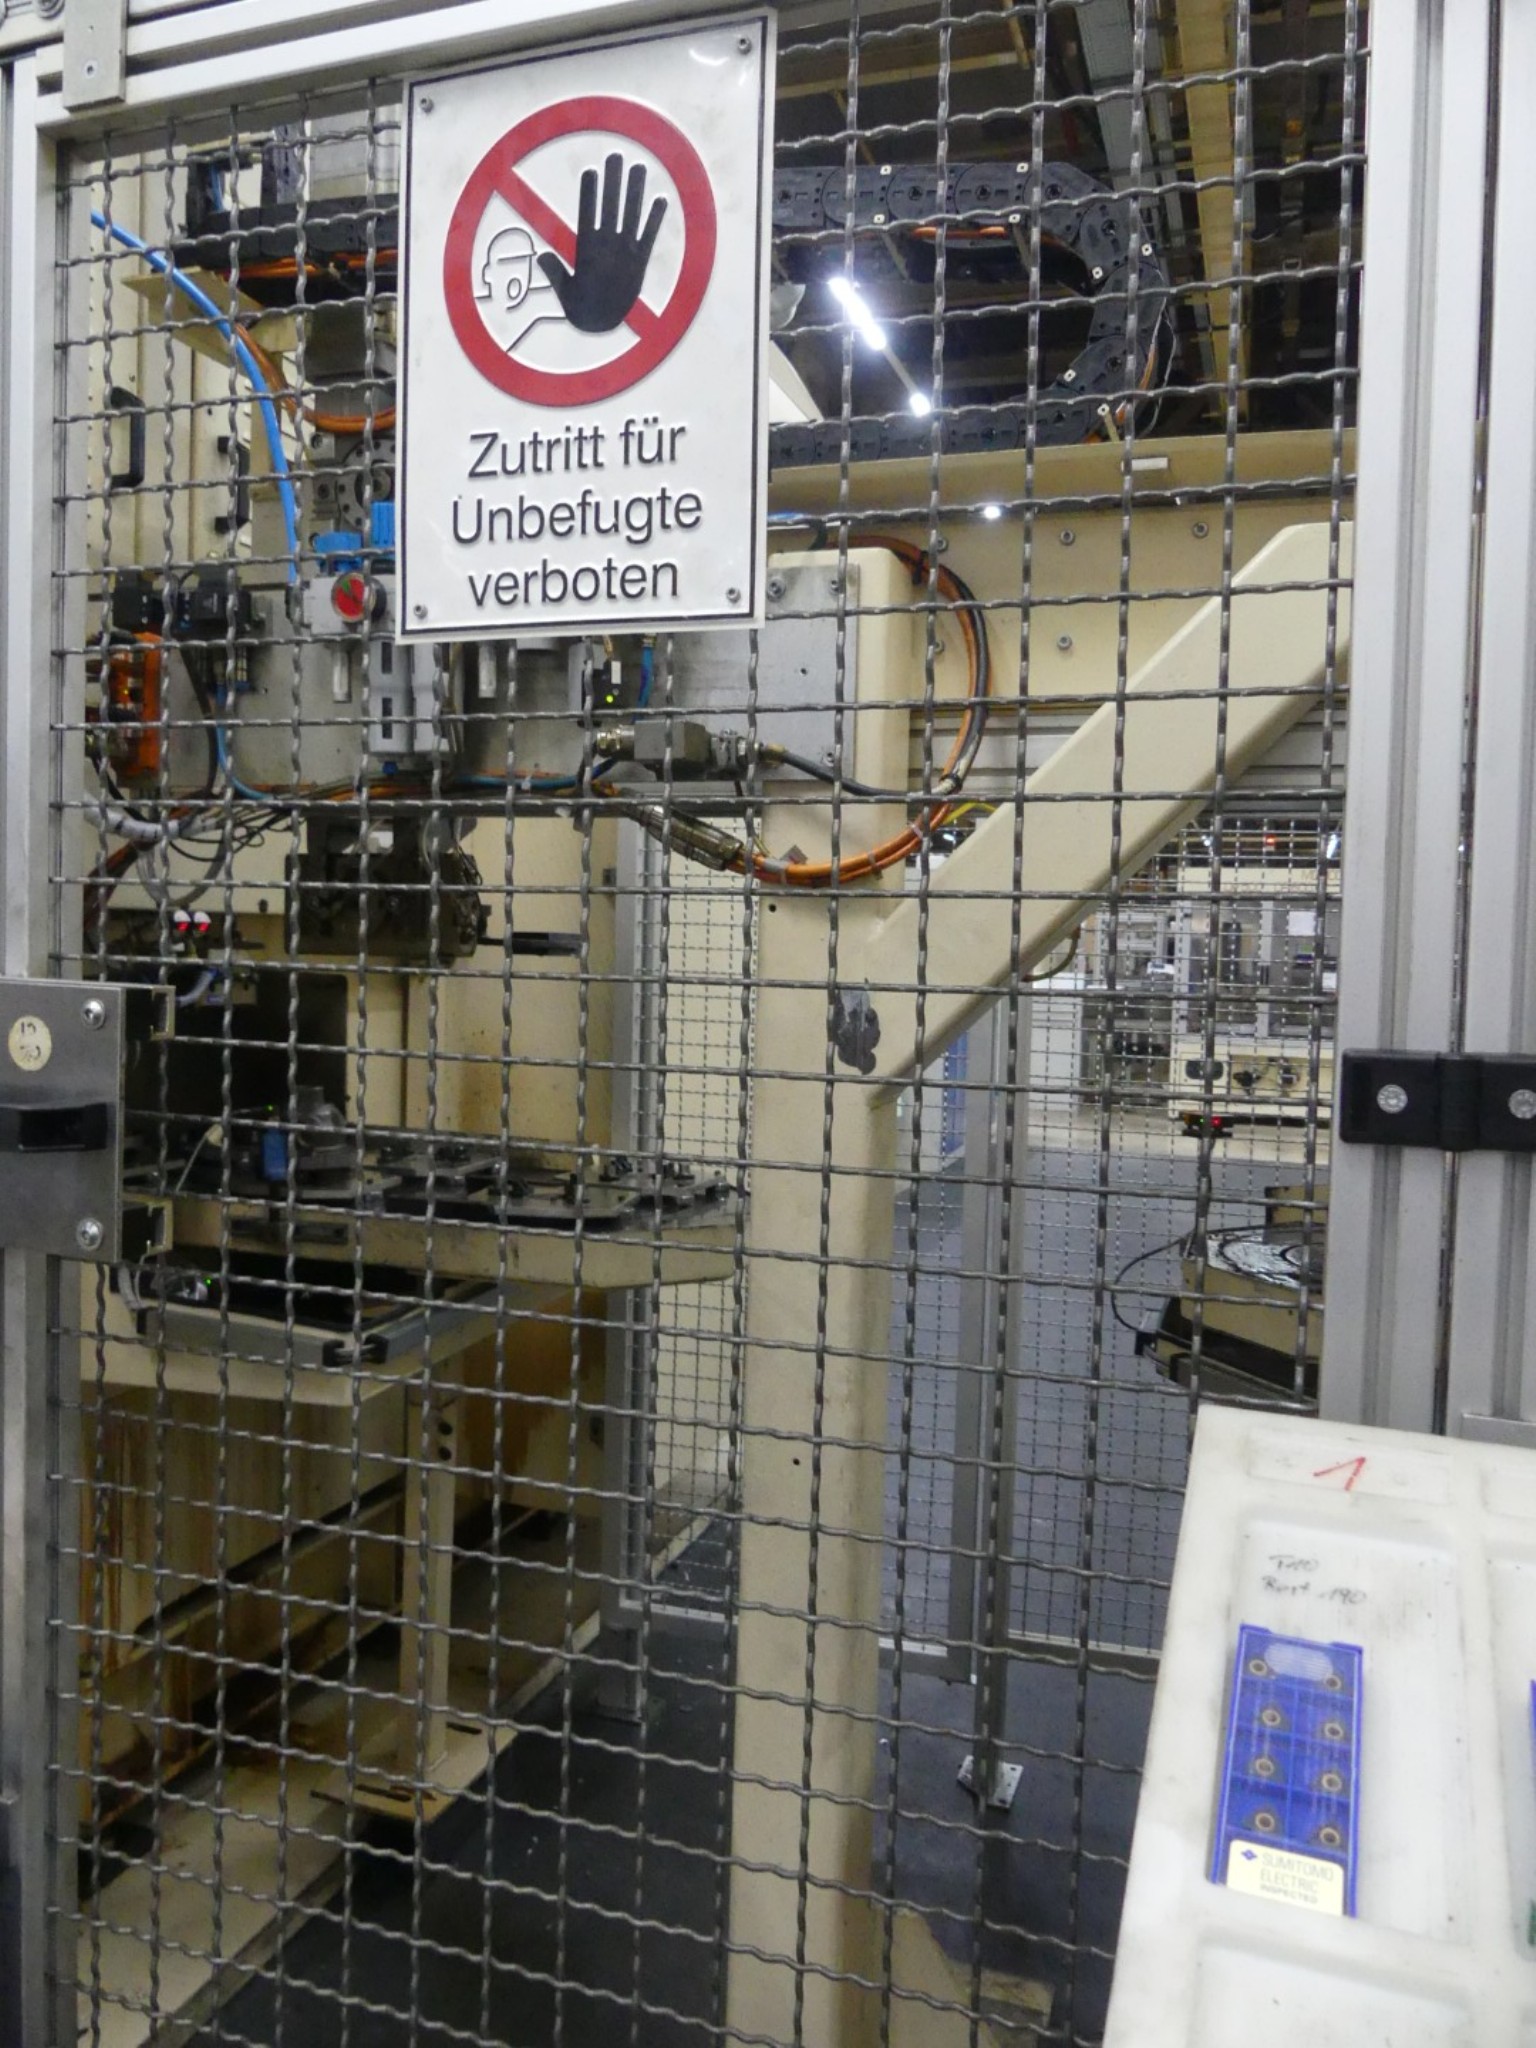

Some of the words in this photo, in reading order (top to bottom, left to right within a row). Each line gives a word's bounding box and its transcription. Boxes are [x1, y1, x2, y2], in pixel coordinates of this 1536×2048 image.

[467, 425, 606, 479] Zutritt
[618, 416, 687, 465] für
[452, 486, 703, 545] Unbefugte
[467, 557, 679, 608] verboten
[1259, 1867, 1320, 1895] ELECTRIC
[1261, 1851, 1335, 1882] SUMITOMO
